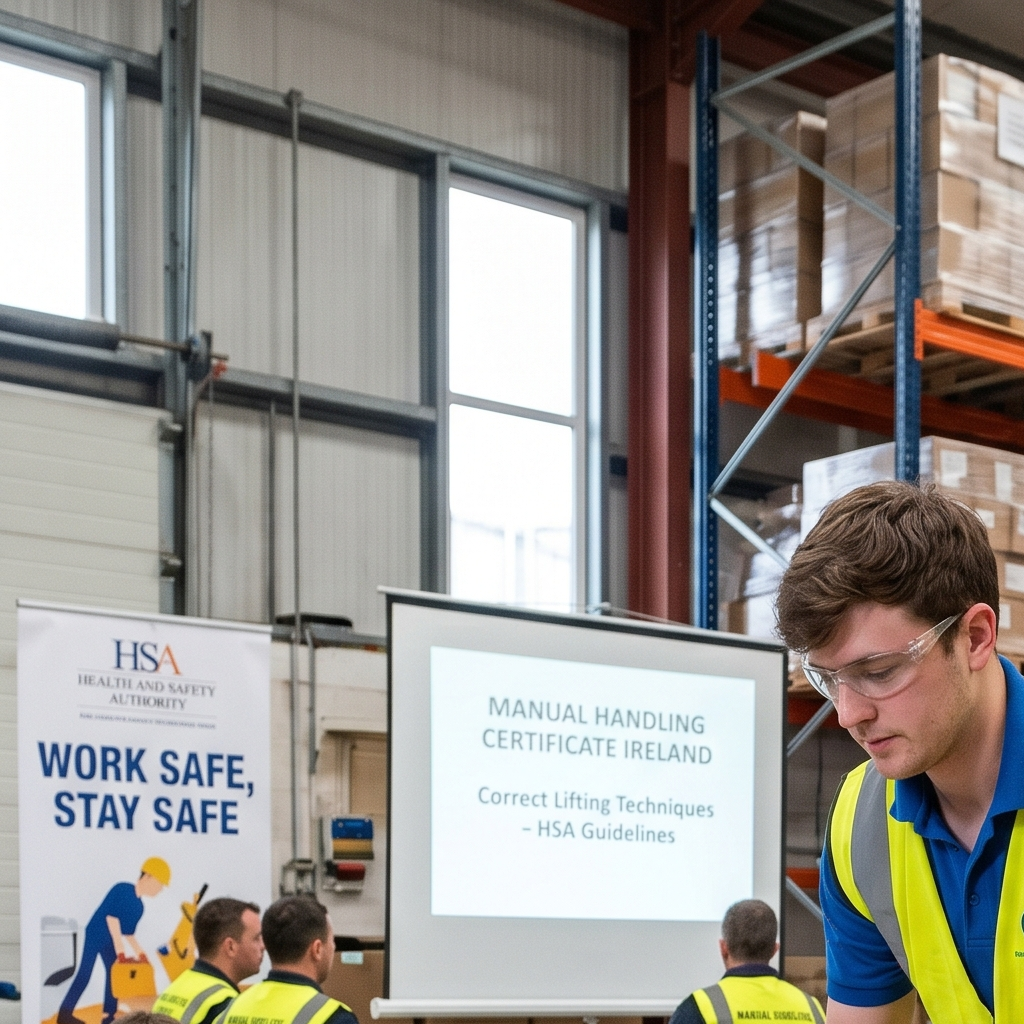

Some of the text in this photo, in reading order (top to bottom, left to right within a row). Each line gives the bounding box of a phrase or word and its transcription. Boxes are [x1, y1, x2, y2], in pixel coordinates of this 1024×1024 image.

[112, 638, 182, 676] HSA
[78, 674, 216, 698] HEALTH AND SAFETY
[109, 694, 188, 711] AUTHORITY
[488, 696, 706, 735] MANUAL HANDLING
[482, 728, 713, 765] CERTIFICATE IRELAND
[37, 741, 254, 798] WORK SAFE,
[54, 791, 239, 835] STAY SAFE
[478, 786, 715, 820] Correct Lifting Techniques
[537, 820, 576, 839] HSA
[581, 822, 676, 844] Guidelines
